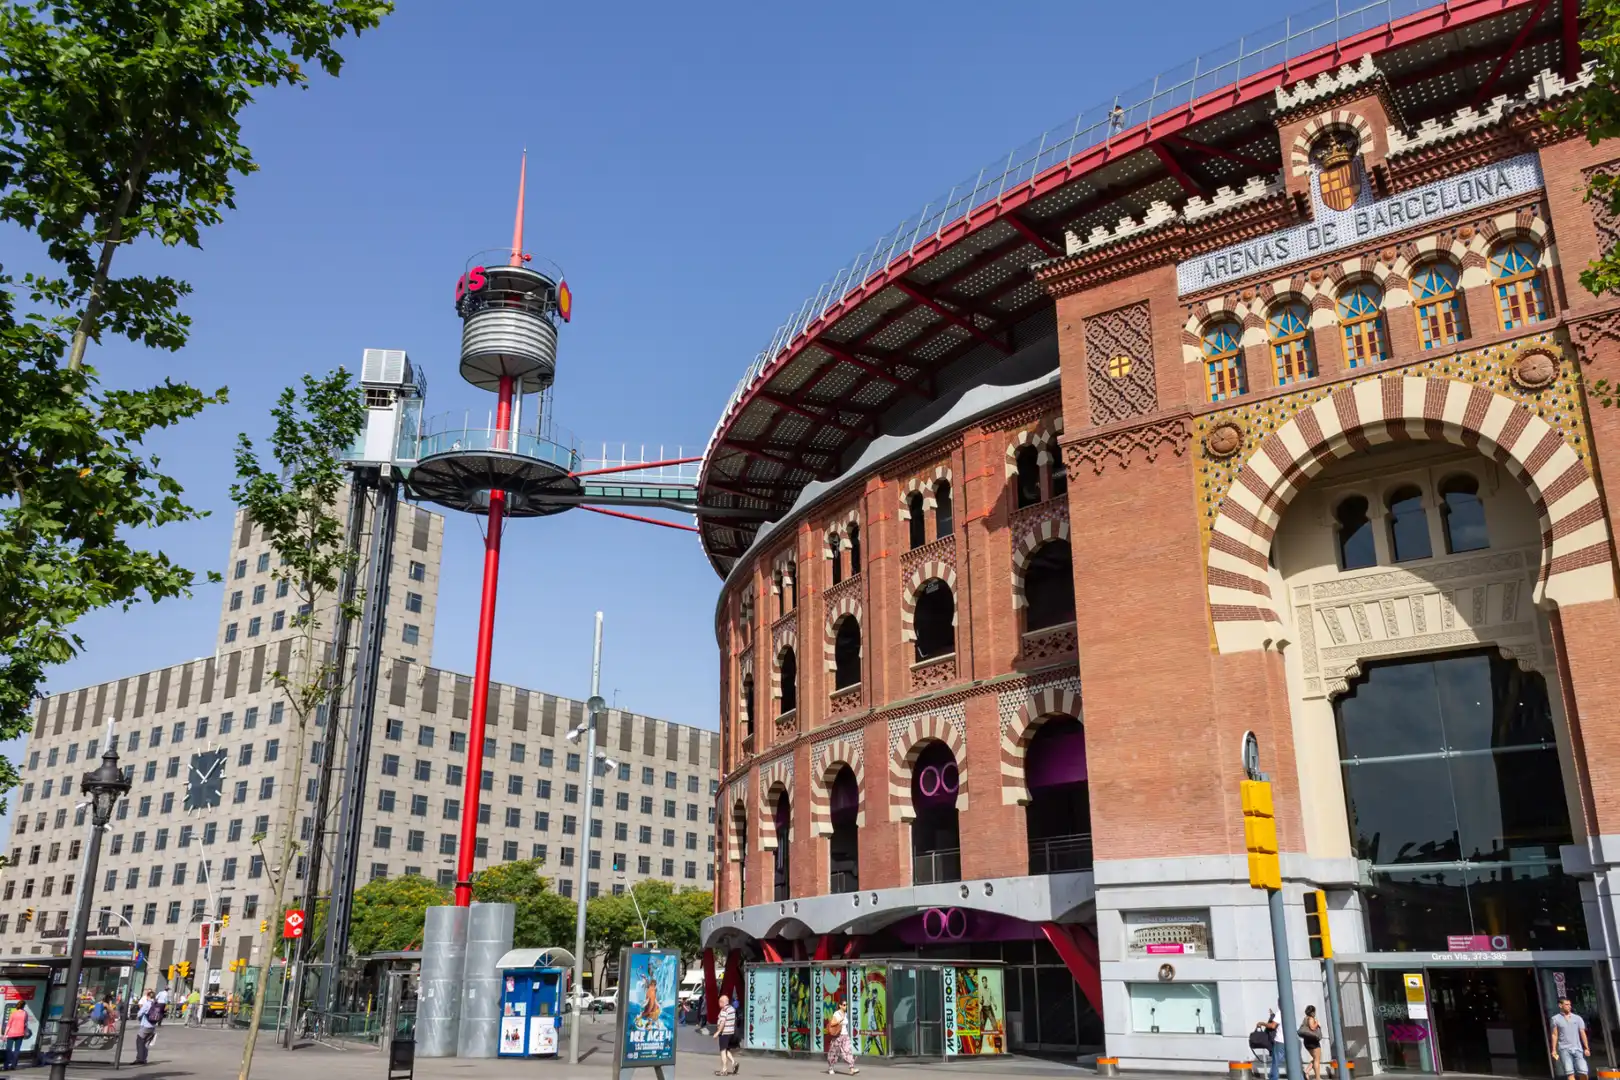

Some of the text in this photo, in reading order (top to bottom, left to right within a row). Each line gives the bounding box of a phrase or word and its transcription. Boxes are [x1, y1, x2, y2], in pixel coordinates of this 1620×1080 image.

[1200, 170, 1513, 283] ARENAS DE BARCELONA
[1472, 952, 1507, 960] 373-385
[945, 968, 953, 1003] ROCK
